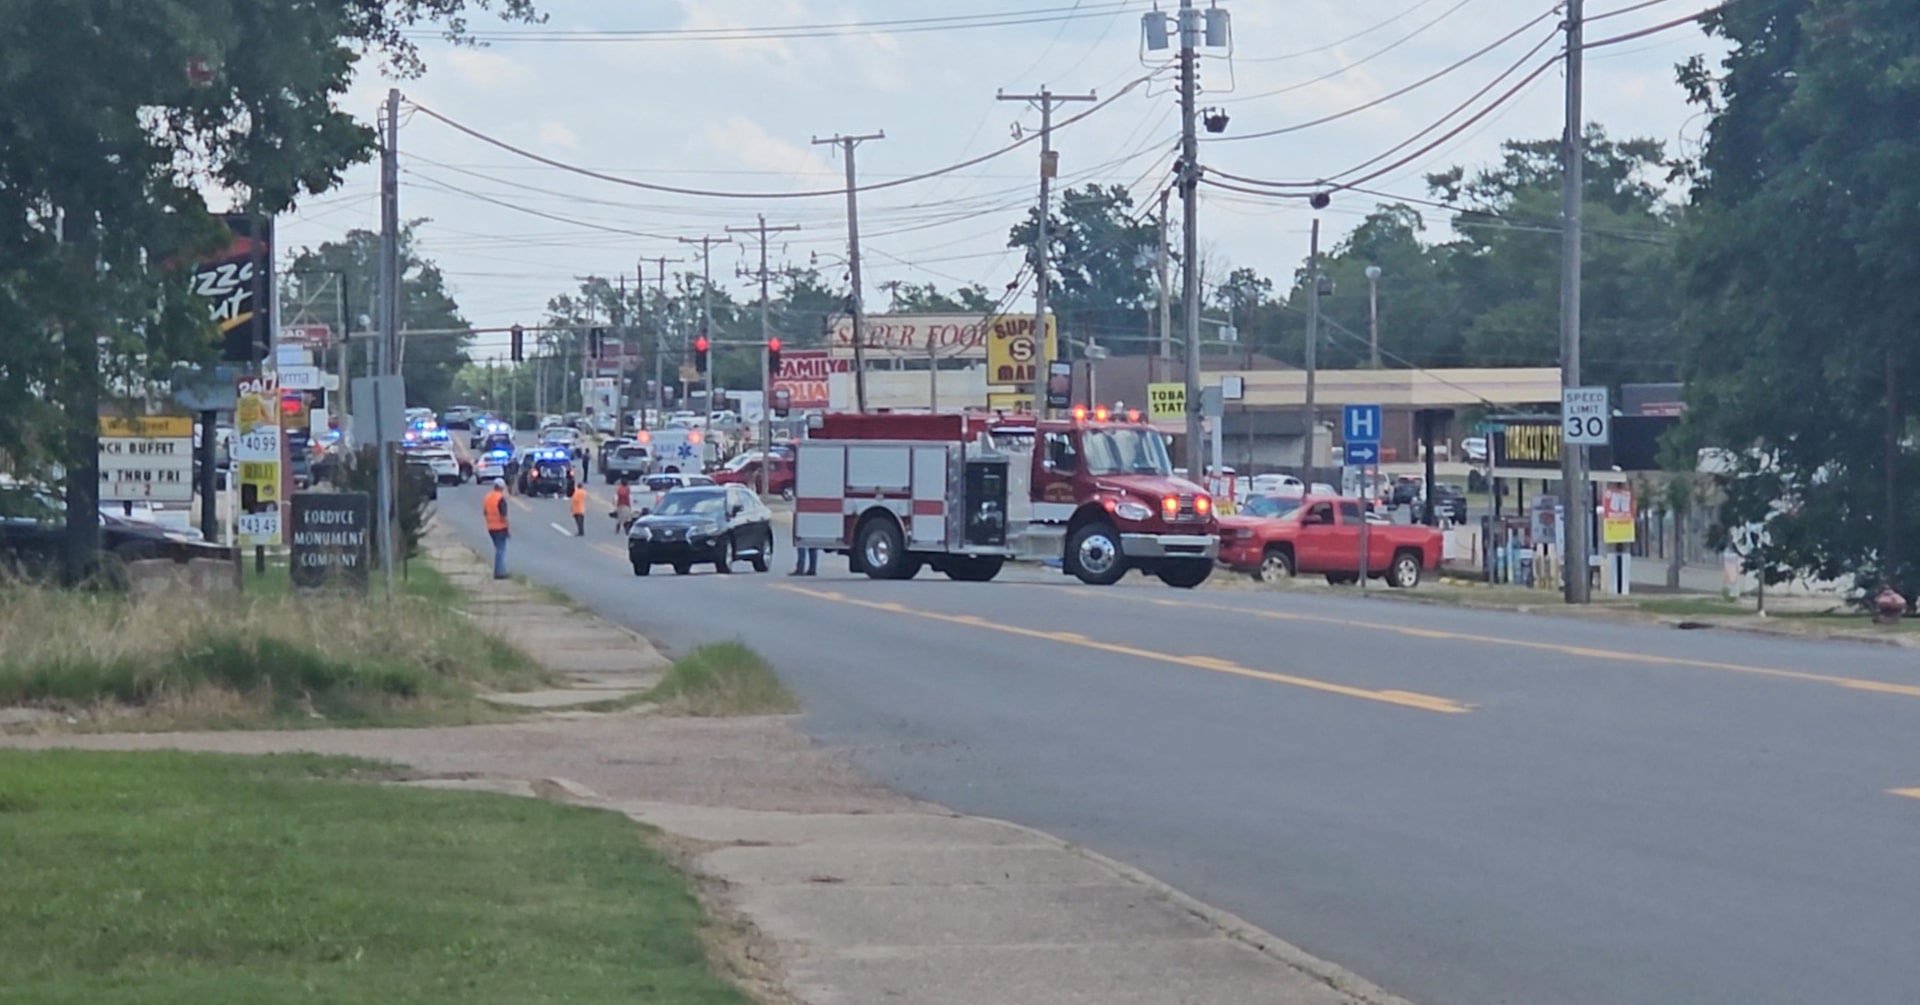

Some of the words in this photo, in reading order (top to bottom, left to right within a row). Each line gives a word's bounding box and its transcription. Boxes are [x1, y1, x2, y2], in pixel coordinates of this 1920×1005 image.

[187, 262, 253, 296] izza
[207, 287, 253, 320] ut
[838, 324, 915, 347] SPER
[774, 359, 843, 378] FAMILY
[998, 365, 1037, 381] MAR
[279, 372, 309, 384] arma
[1151, 391, 1185, 401] TOBA
[1566, 393, 1604, 402] SPEED
[1570, 405, 1599, 414] LIMIT
[1352, 410, 1373, 436] H
[1568, 417, 1603, 437] 30
[129, 443, 174, 454] BUFFET
[118, 471, 151, 481] THRU
[158, 471, 179, 481] FRI
[144, 484, 151, 496] 2
[304, 510, 354, 524] FORDYCE
[294, 532, 363, 545] MONUMENT
